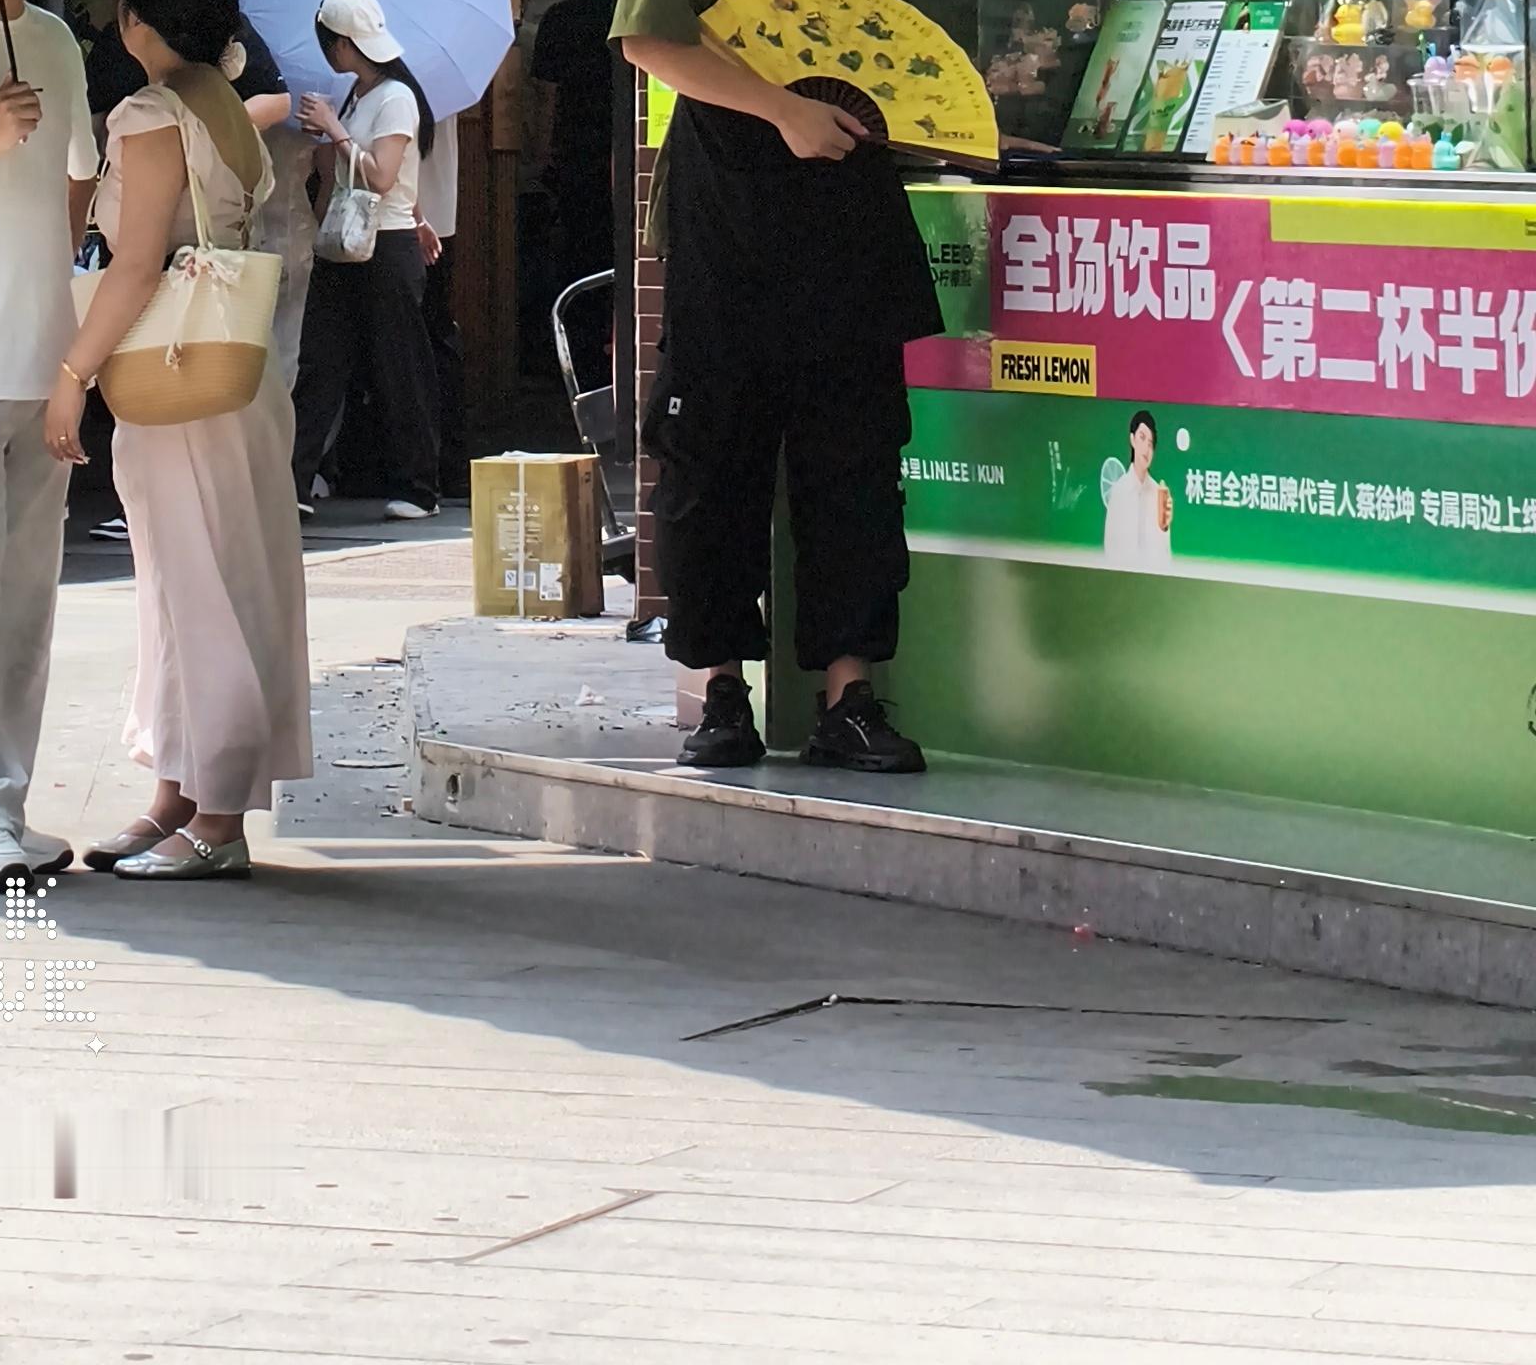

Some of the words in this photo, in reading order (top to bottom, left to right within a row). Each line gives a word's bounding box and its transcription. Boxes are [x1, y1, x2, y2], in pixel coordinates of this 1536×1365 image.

[1001, 215, 1216, 321] 全场饮品
[1000, 353, 1041, 383] FRESH
[1044, 355, 1090, 384] LEMON
[977, 464, 1005, 485] KUN
[1186, 469, 1415, 524] 林里全球品牌代言人蔡徐坤
